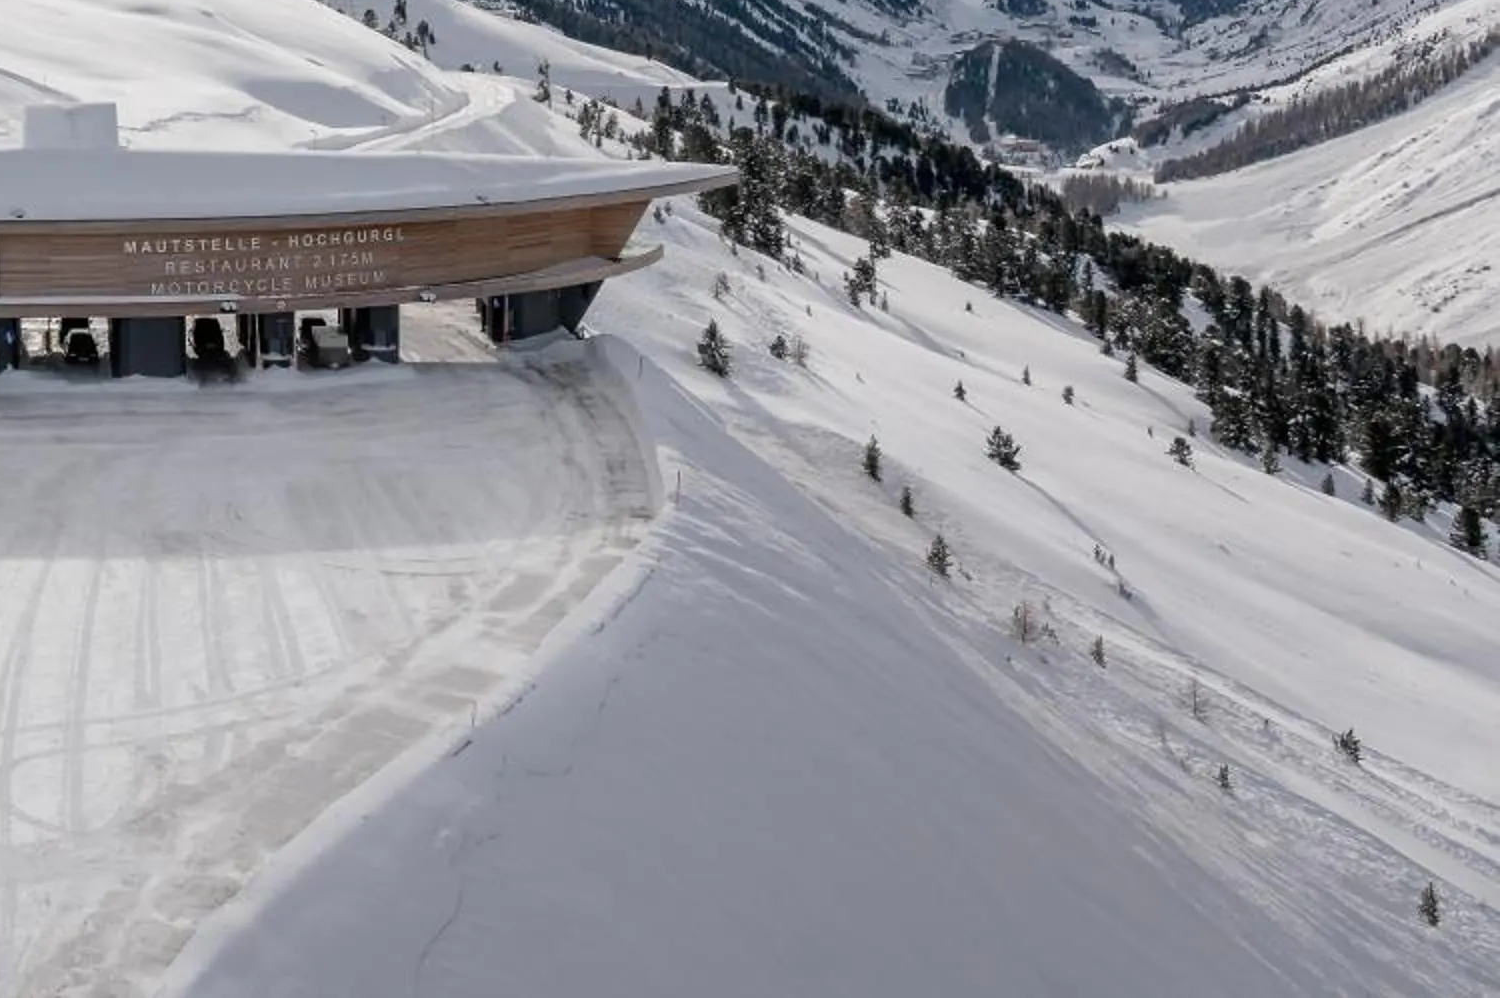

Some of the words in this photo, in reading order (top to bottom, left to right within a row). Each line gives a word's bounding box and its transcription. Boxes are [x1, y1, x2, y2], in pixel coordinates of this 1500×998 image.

[122, 237, 261, 254] MAUTSTELLE
[164, 255, 302, 275] RESTAURANT
[150, 277, 293, 295] MOTORCYCLE
[305, 270, 385, 290] MUSEUM
